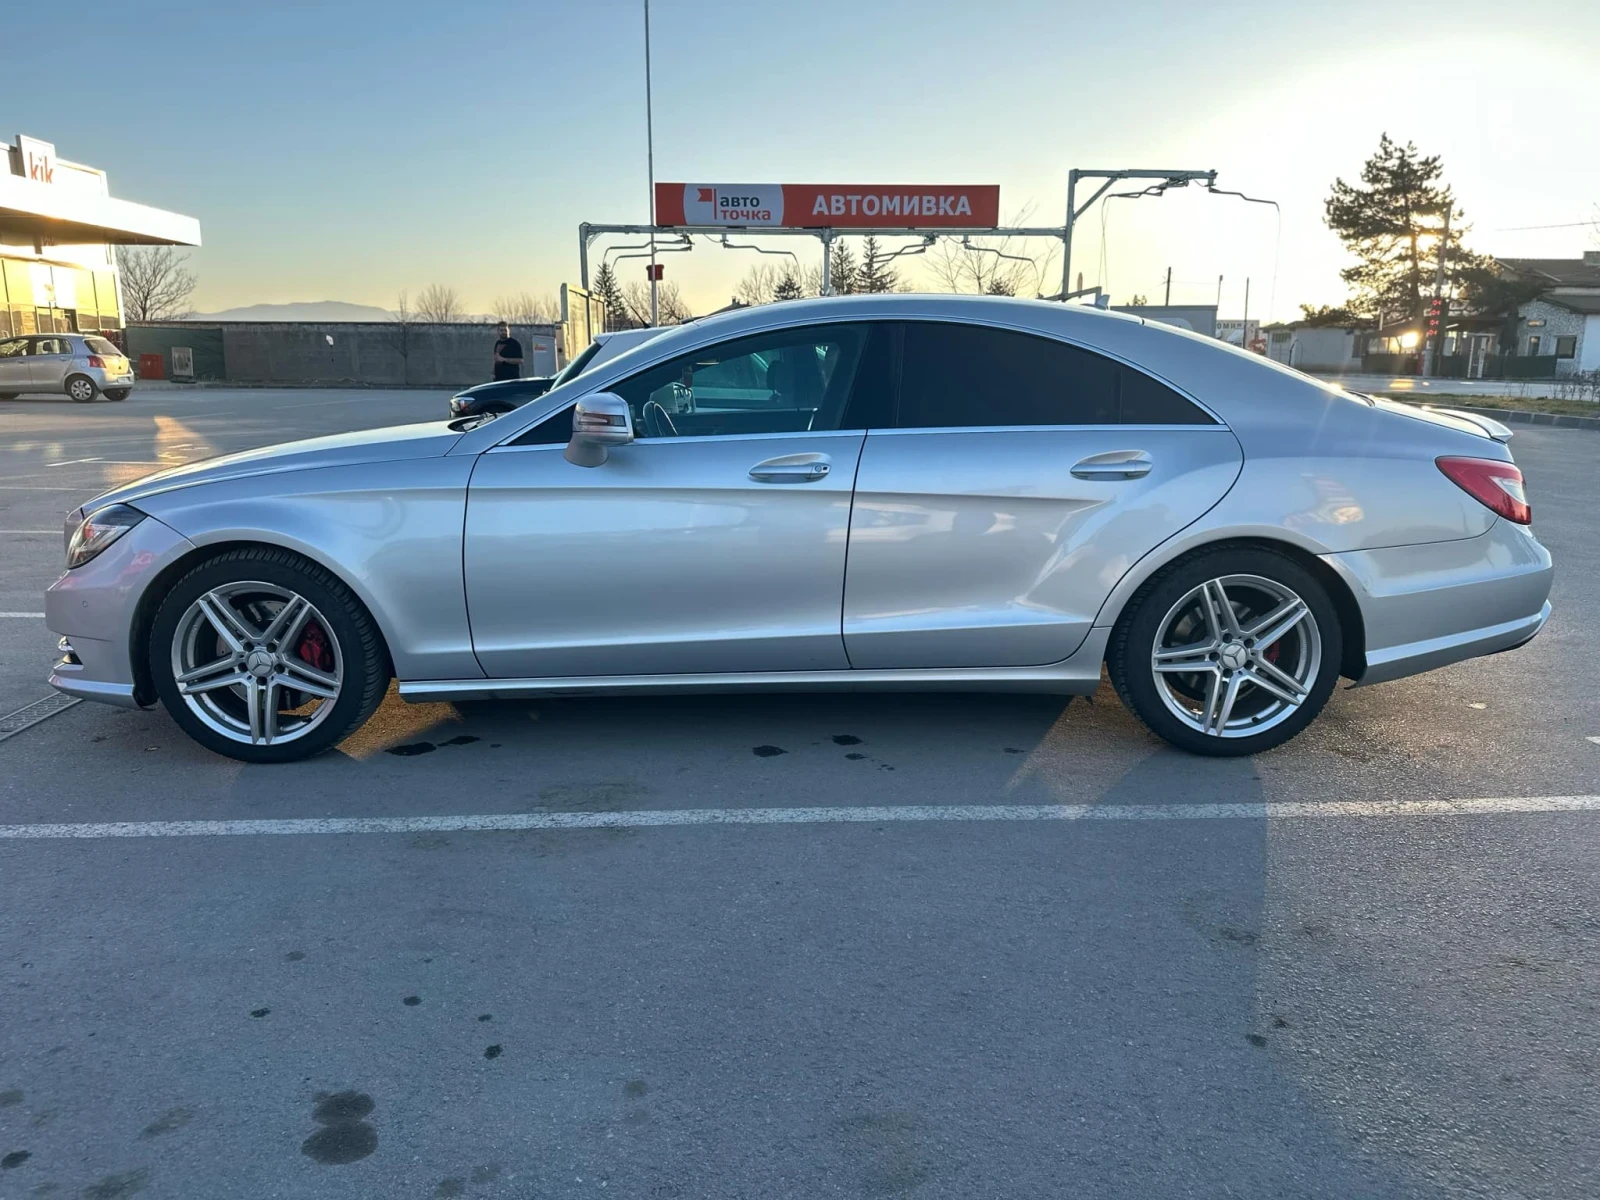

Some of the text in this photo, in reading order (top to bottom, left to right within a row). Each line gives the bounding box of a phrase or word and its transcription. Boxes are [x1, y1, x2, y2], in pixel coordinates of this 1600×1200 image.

[29, 151, 54, 184] kik
[720, 196, 760, 208] авто
[812, 195, 972, 216] АВТОМИВКА
[720, 209, 772, 221] точка
